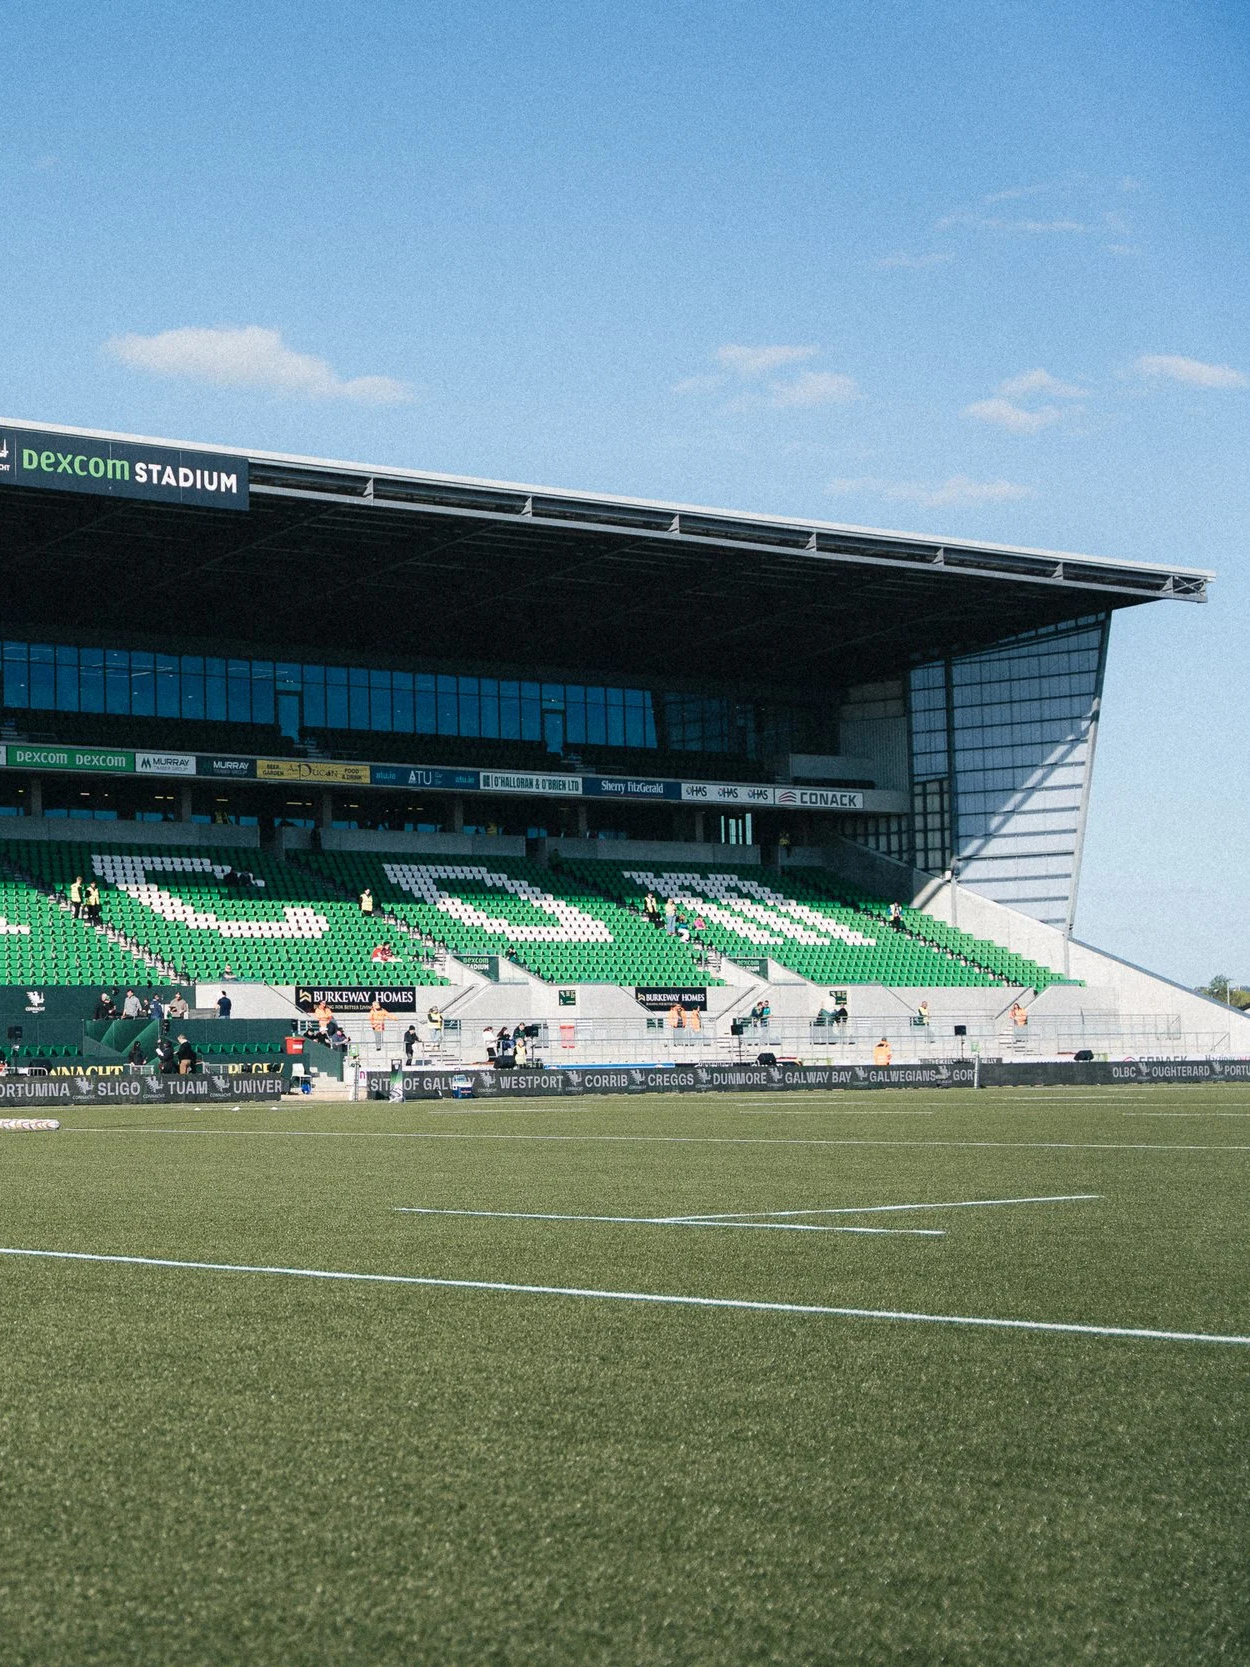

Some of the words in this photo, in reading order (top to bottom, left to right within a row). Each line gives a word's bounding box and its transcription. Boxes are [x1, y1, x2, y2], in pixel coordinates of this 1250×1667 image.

[135, 462, 237, 493] STADIUM
[152, 758, 189, 766] MURRAY
[213, 761, 249, 769] MURRAY
[408, 770, 431, 784] ATU
[494, 776, 534, 789] O'HALLORAN
[536, 779, 540, 789] &
[542, 779, 566, 791] O'BRIEN
[568, 781, 579, 792] LTD
[601, 780, 625, 794] Sherry
[628, 781, 664, 794] FitzGerald
[800, 792, 856, 806] CONACK
[314, 991, 371, 1002] BURKEWAY
[375, 991, 413, 1002] HOMES
[646, 993, 680, 1001] BURKEWAY
[682, 993, 704, 1002] HOMES
[870, 1070, 937, 1082] GALWEGIANS
[1112, 1066, 1136, 1078] OLBC
[1152, 1065, 1210, 1077] OUGHTERARD
[404, 1078, 420, 1090] OF
[500, 1076, 563, 1088] WESTPORT
[585, 1075, 628, 1087] CORRIB
[648, 1073, 694, 1086] CREGGS
[713, 1072, 767, 1084] DUNMORE
[785, 1072, 829, 1084] GALWAY
[832, 1072, 852, 1083] BAY
[98, 1082, 140, 1096] SLIGO
[168, 1081, 208, 1094] TUAM
[234, 1079, 282, 1094] UNIVER
